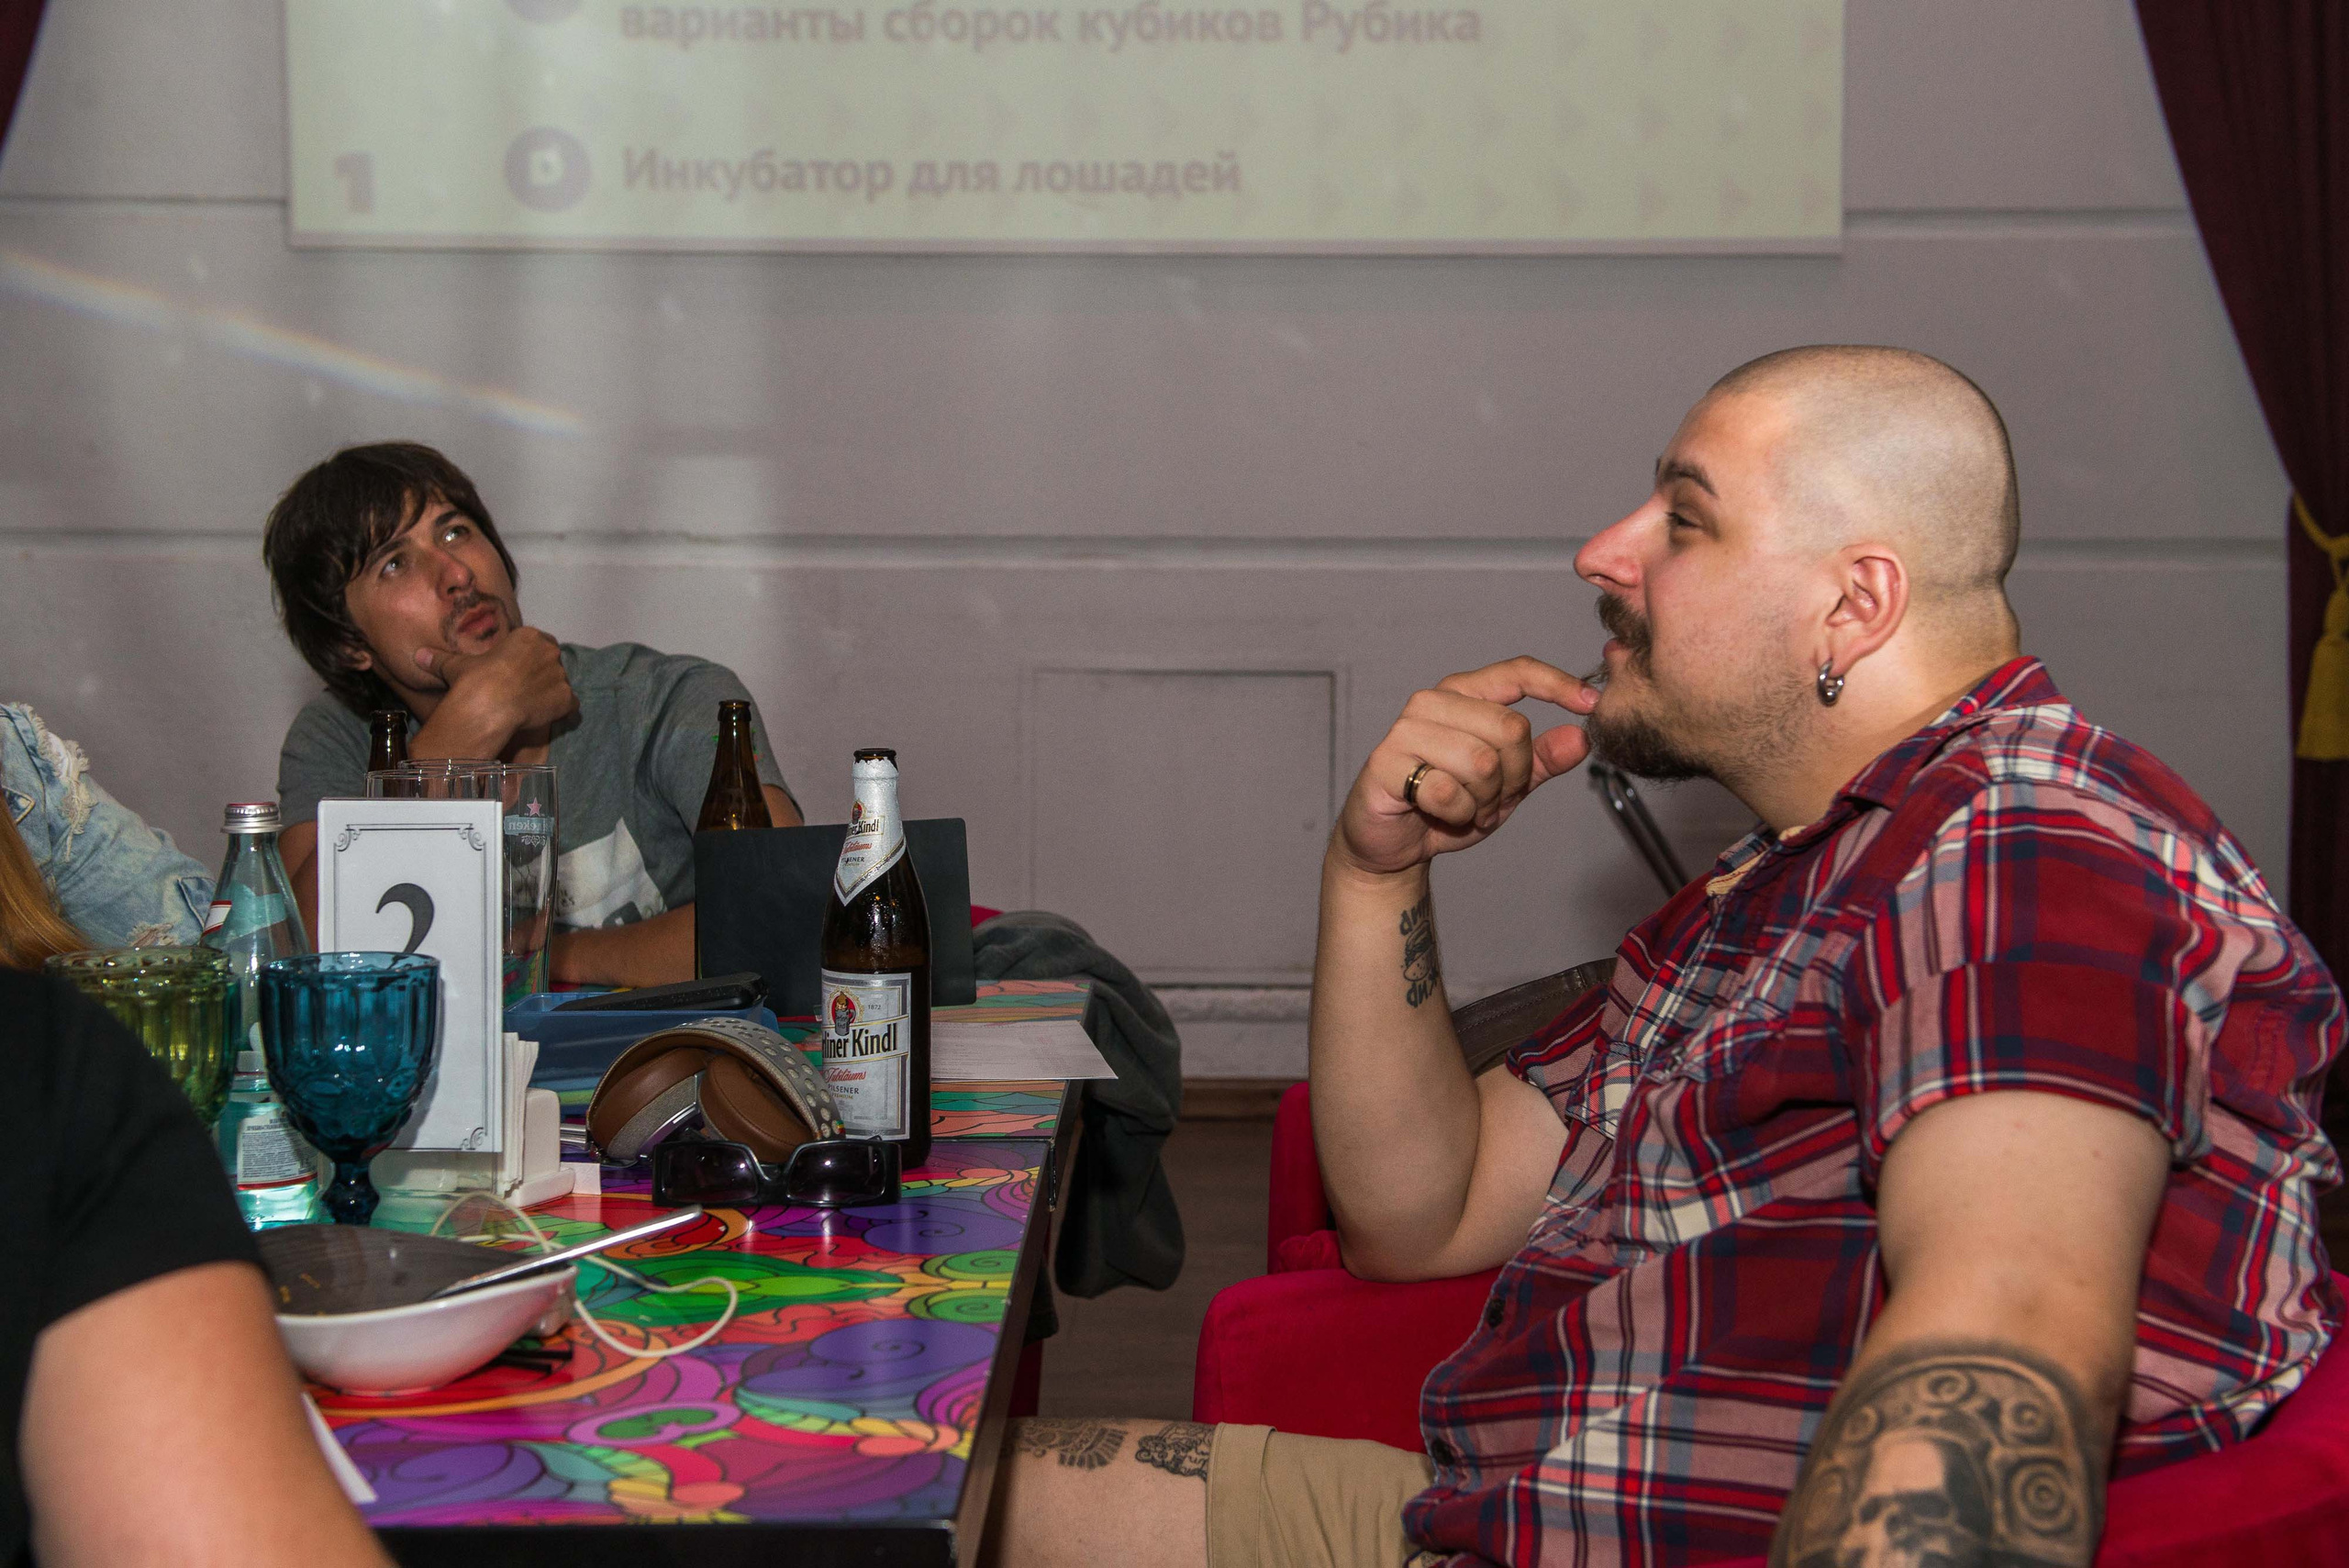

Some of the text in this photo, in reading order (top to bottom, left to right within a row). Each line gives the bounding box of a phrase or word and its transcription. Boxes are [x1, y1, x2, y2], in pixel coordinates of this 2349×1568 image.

[619, 0, 1483, 54] варианты сборок кубиков Рубика
[334, 150, 374, 215] 1
[622, 147, 1242, 204] Инкубатор для лошадей
[375, 883, 436, 969] 2
[852, 1022, 898, 1057] Kindl
[828, 1084, 860, 1095] PILSENER
